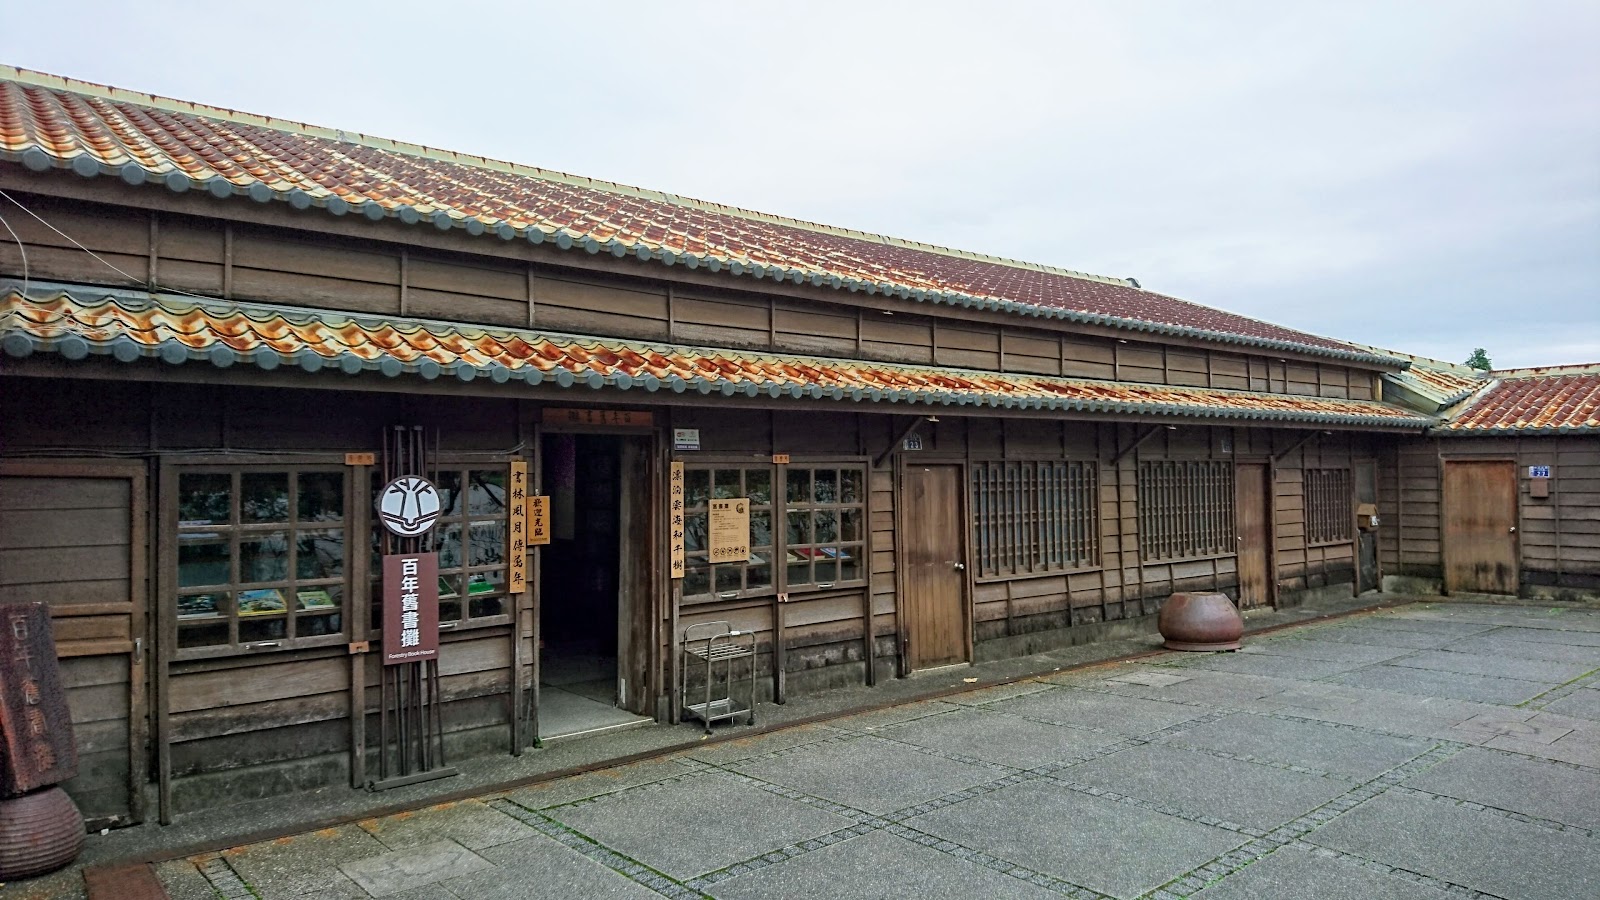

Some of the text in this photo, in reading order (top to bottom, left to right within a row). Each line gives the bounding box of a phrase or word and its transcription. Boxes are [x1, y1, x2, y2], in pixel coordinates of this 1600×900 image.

[533, 499, 544, 537] 歡迎光臨
[401, 558, 419, 647] 百年舊書攤
[388, 652, 408, 660] Forestry
